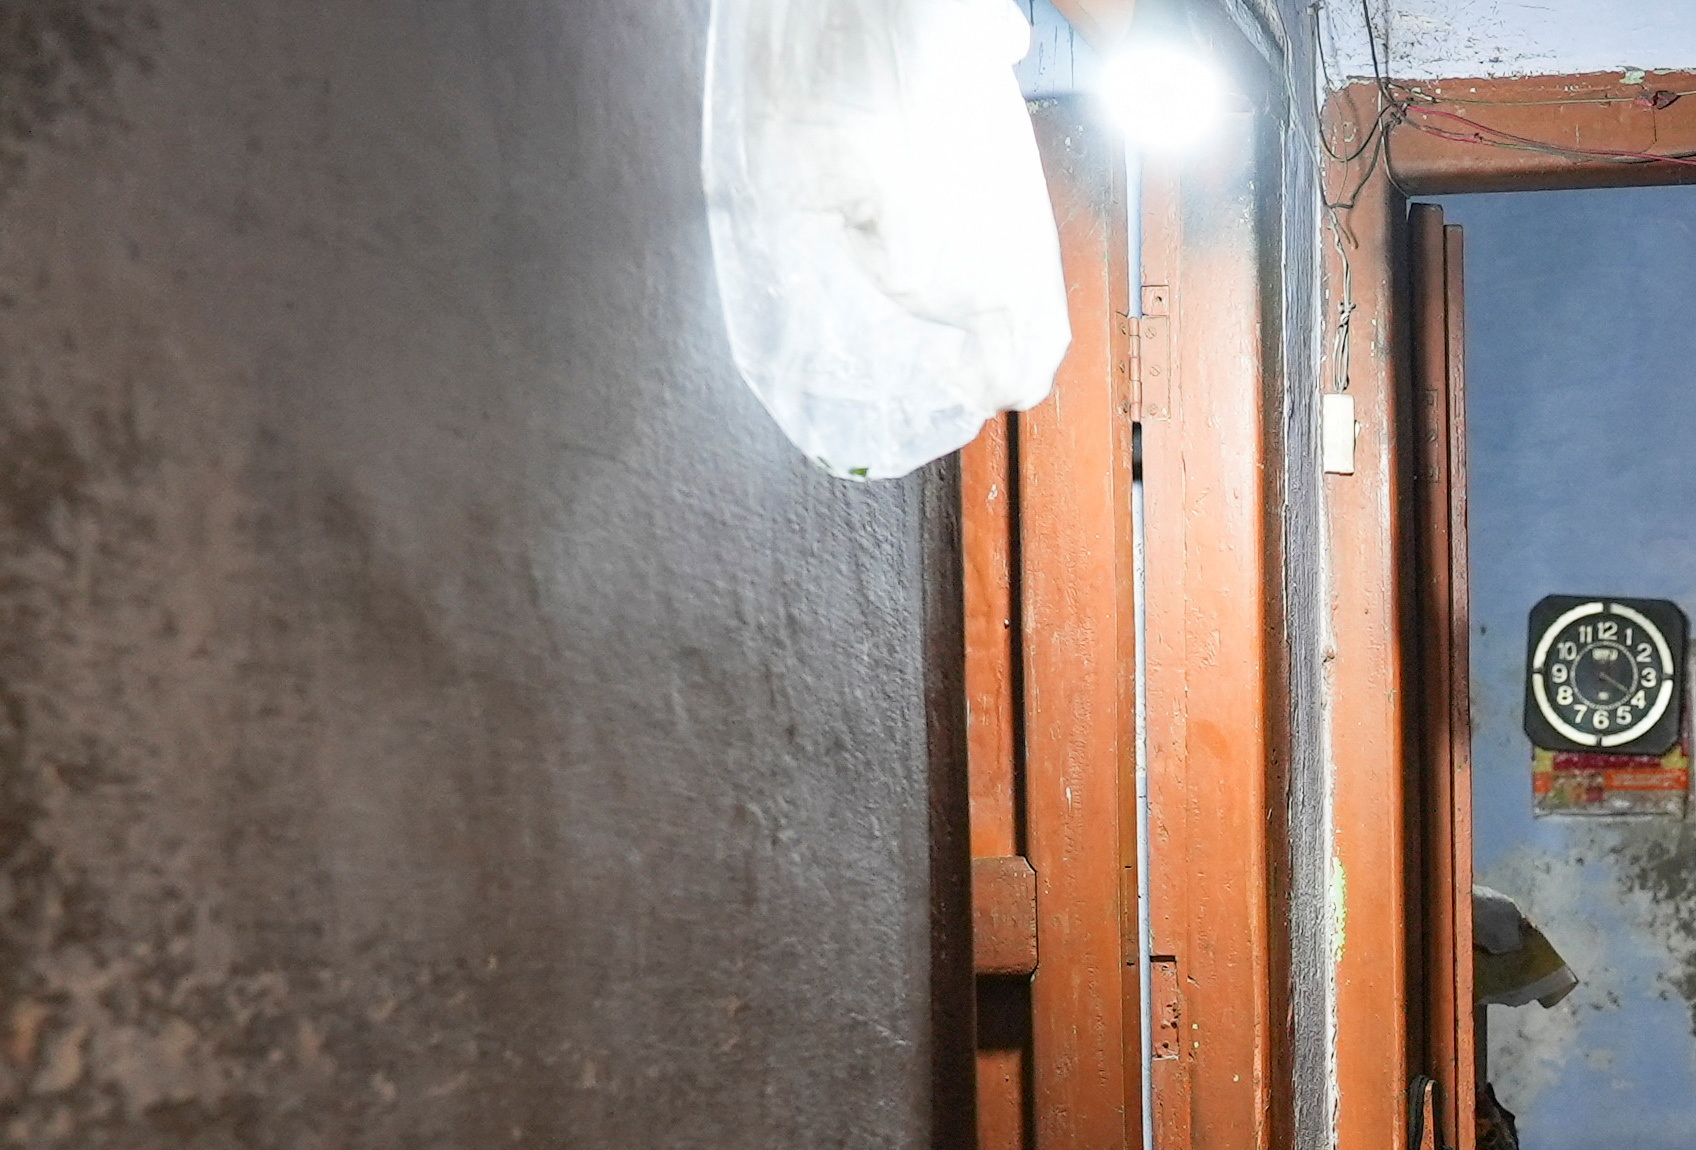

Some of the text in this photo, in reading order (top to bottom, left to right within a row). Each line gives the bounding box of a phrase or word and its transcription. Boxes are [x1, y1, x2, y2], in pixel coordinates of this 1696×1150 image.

[1579, 625, 1593, 643] 11
[1597, 621, 1618, 640] 12
[1625, 628, 1633, 646] 1
[1557, 641, 1577, 661] 10
[1636, 642, 1652, 662] 2
[1551, 663, 1568, 684] 9
[1640, 667, 1657, 688] 3
[1556, 685, 1574, 706] 8
[1630, 690, 1646, 710] 4
[1573, 704, 1588, 724] 7
[1592, 709, 1610, 730] 6
[1616, 705, 1632, 726] 5
